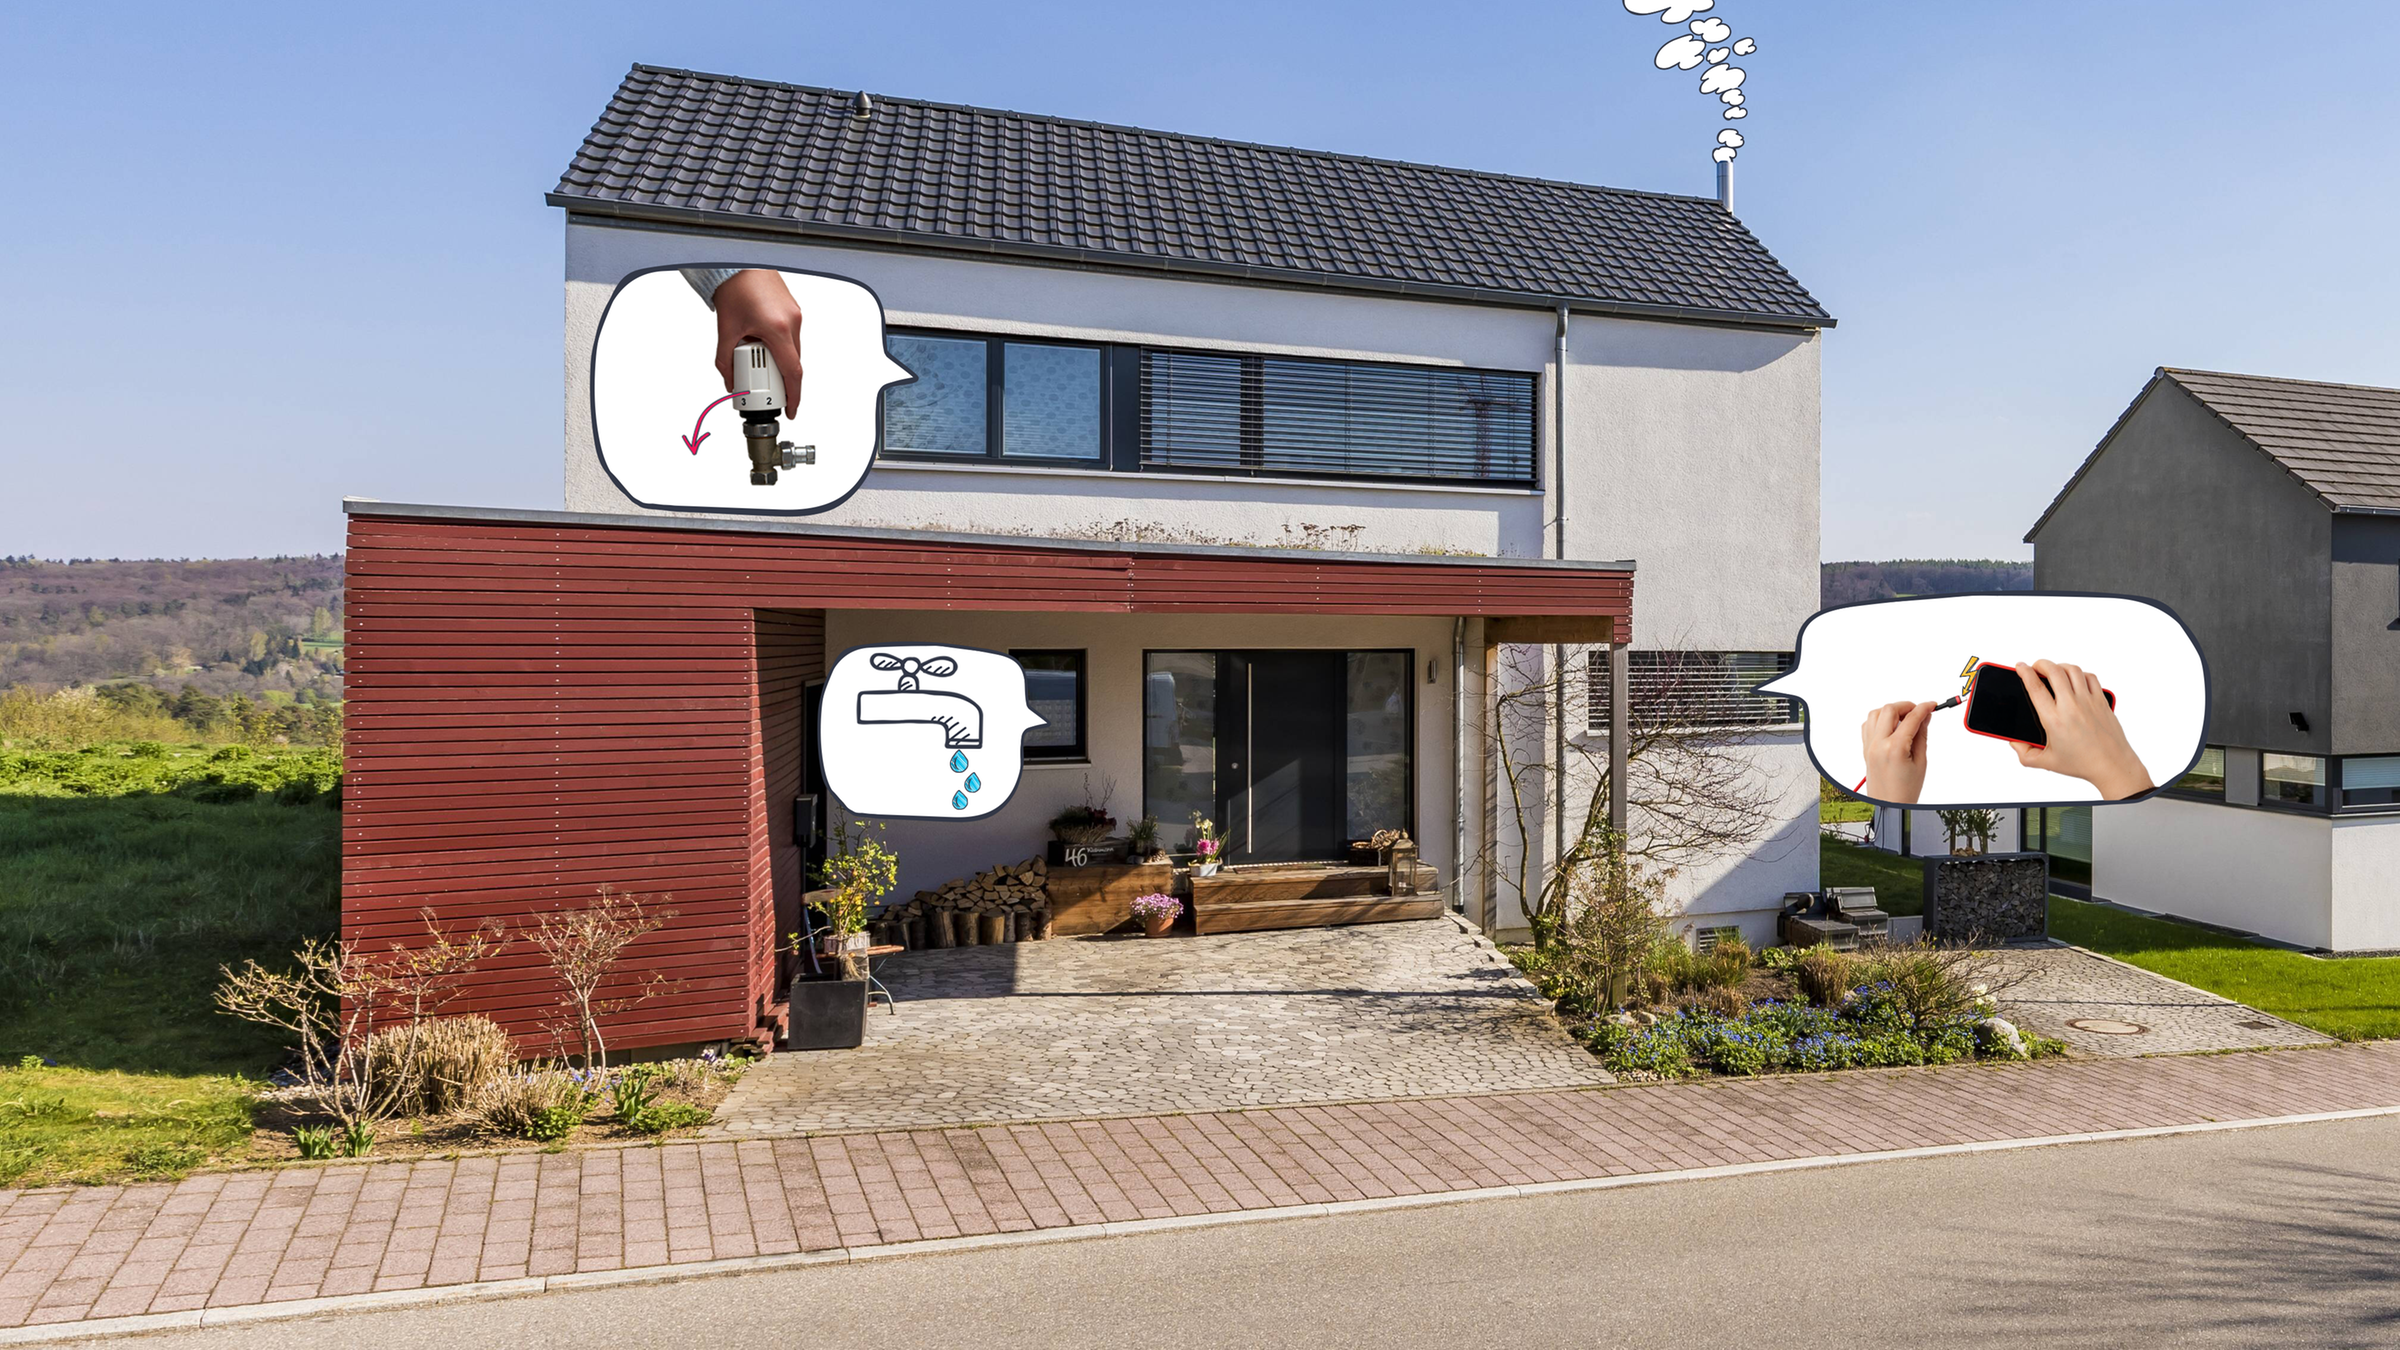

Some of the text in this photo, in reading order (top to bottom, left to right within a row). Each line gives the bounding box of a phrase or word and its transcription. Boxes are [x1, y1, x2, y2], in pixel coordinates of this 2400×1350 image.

[741, 396, 772, 406] 3 2
[1065, 847, 1088, 867] 46
